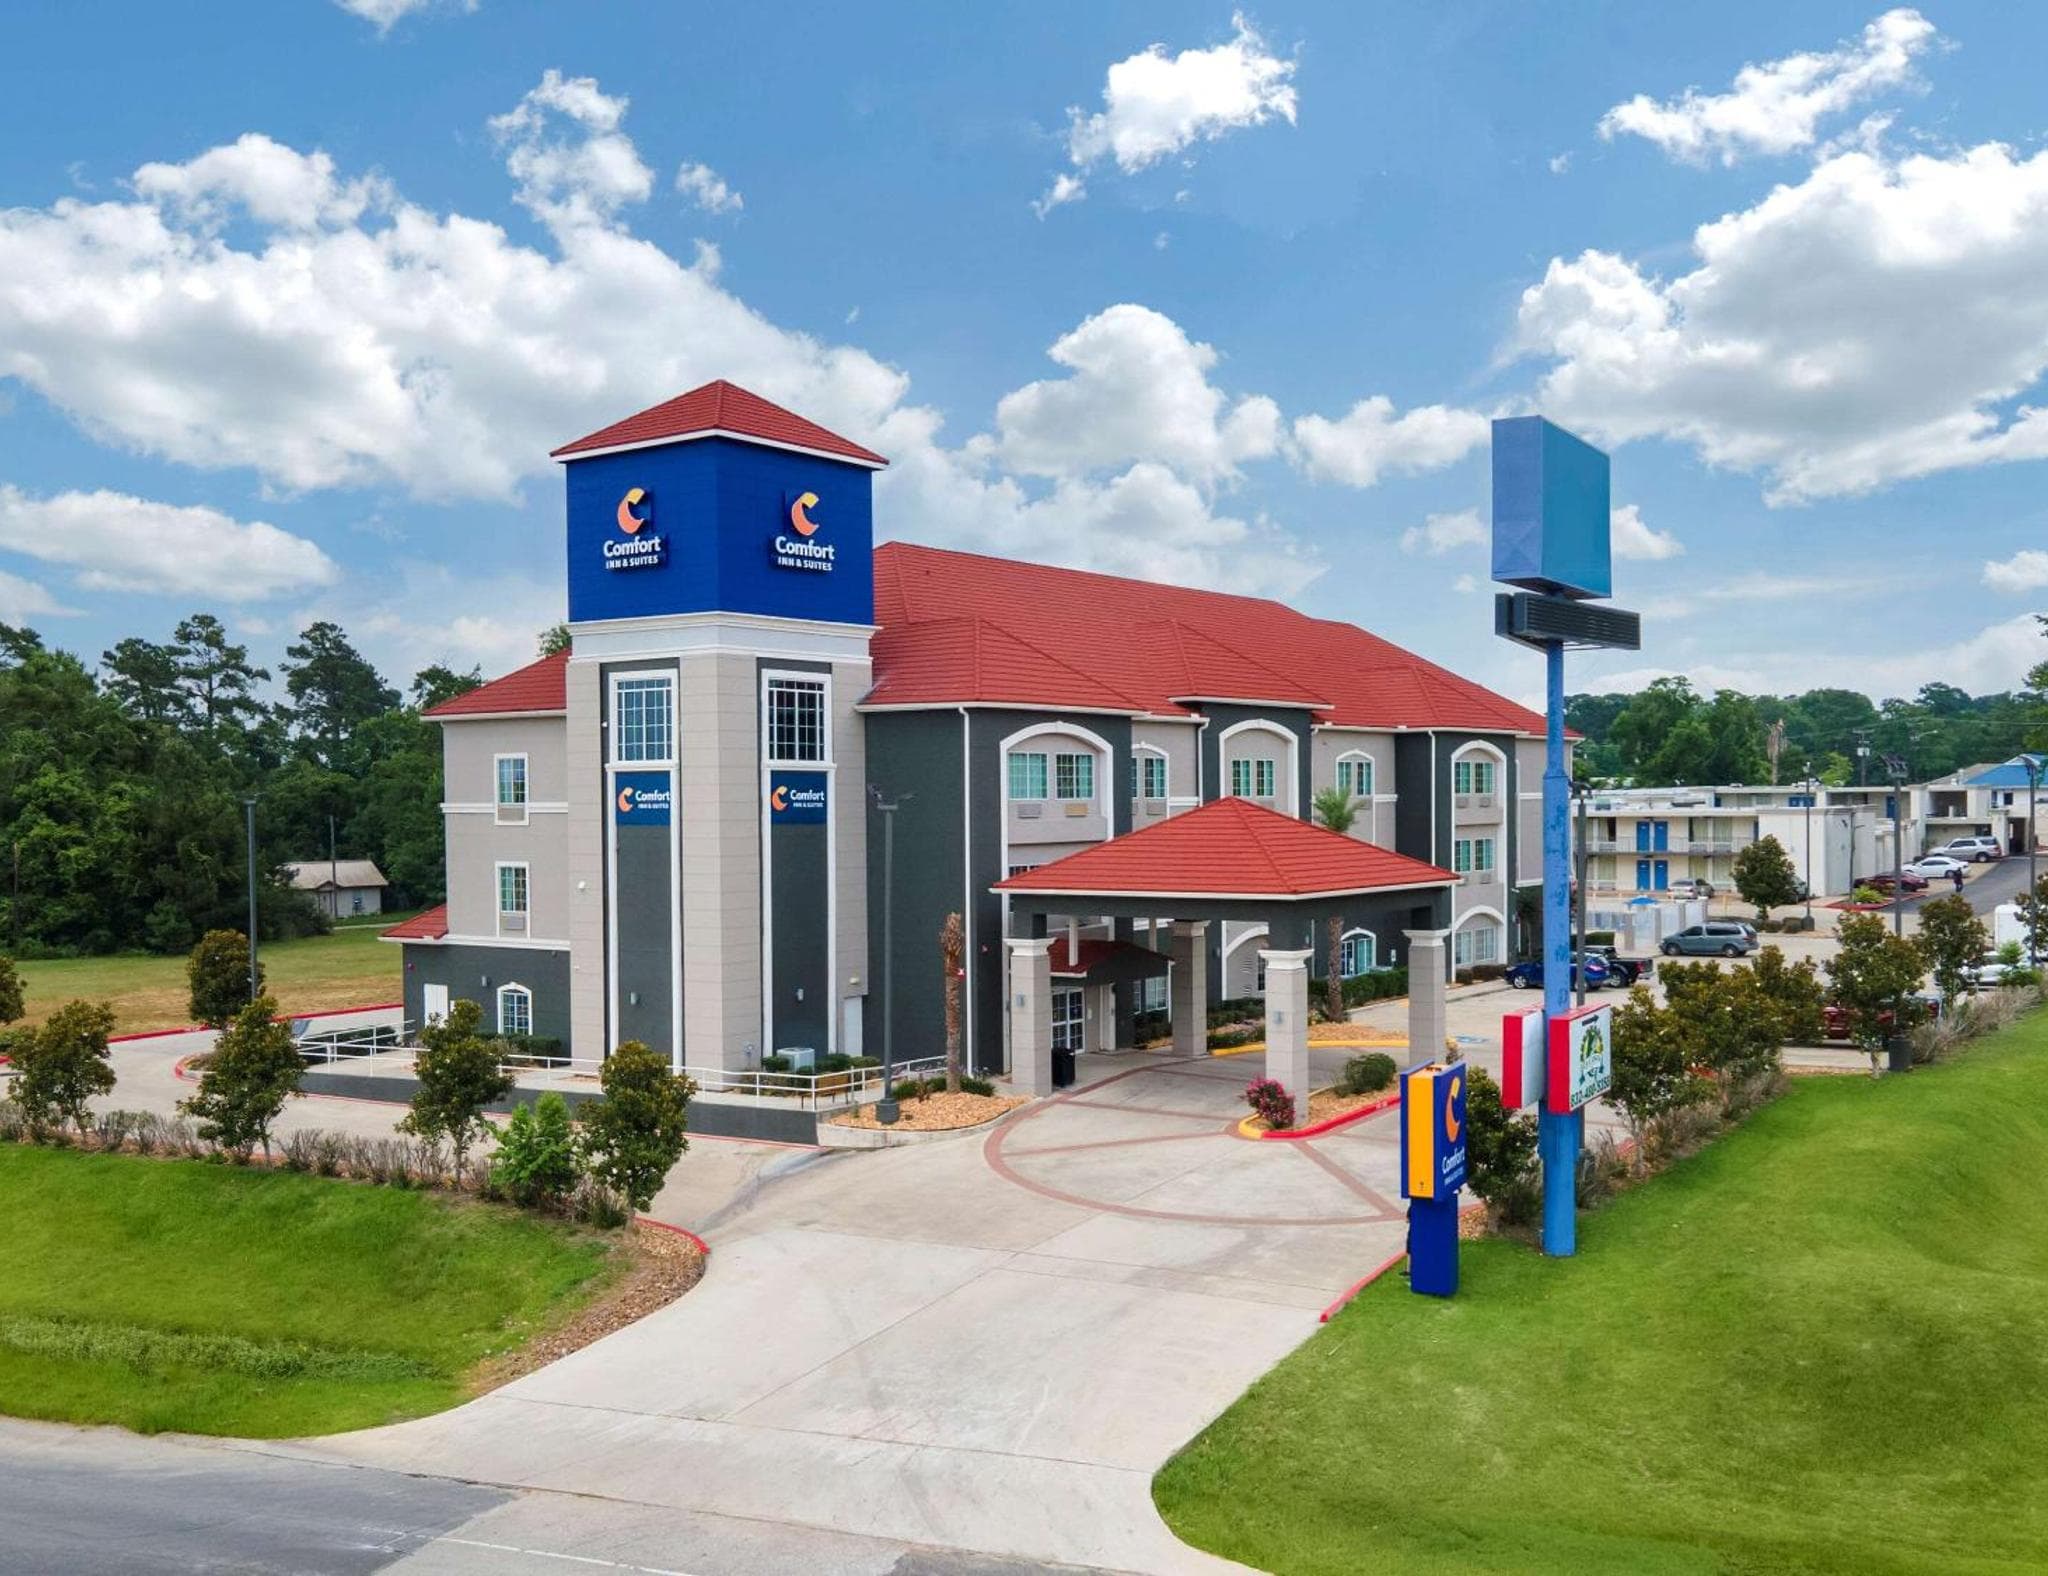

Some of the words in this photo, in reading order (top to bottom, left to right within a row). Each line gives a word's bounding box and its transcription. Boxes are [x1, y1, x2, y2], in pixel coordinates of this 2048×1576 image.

[603, 535, 661, 557] Comfort
[775, 536, 835, 560] Comfort
[605, 559, 621, 569] INN
[622, 558, 629, 567] &
[629, 555, 659, 567] SUITES
[777, 556, 794, 567] INN
[803, 559, 832, 571] SUITES
[635, 789, 670, 801] Comfort
[790, 789, 825, 801] Comfort
[1441, 1146, 1465, 1174] Comfort
